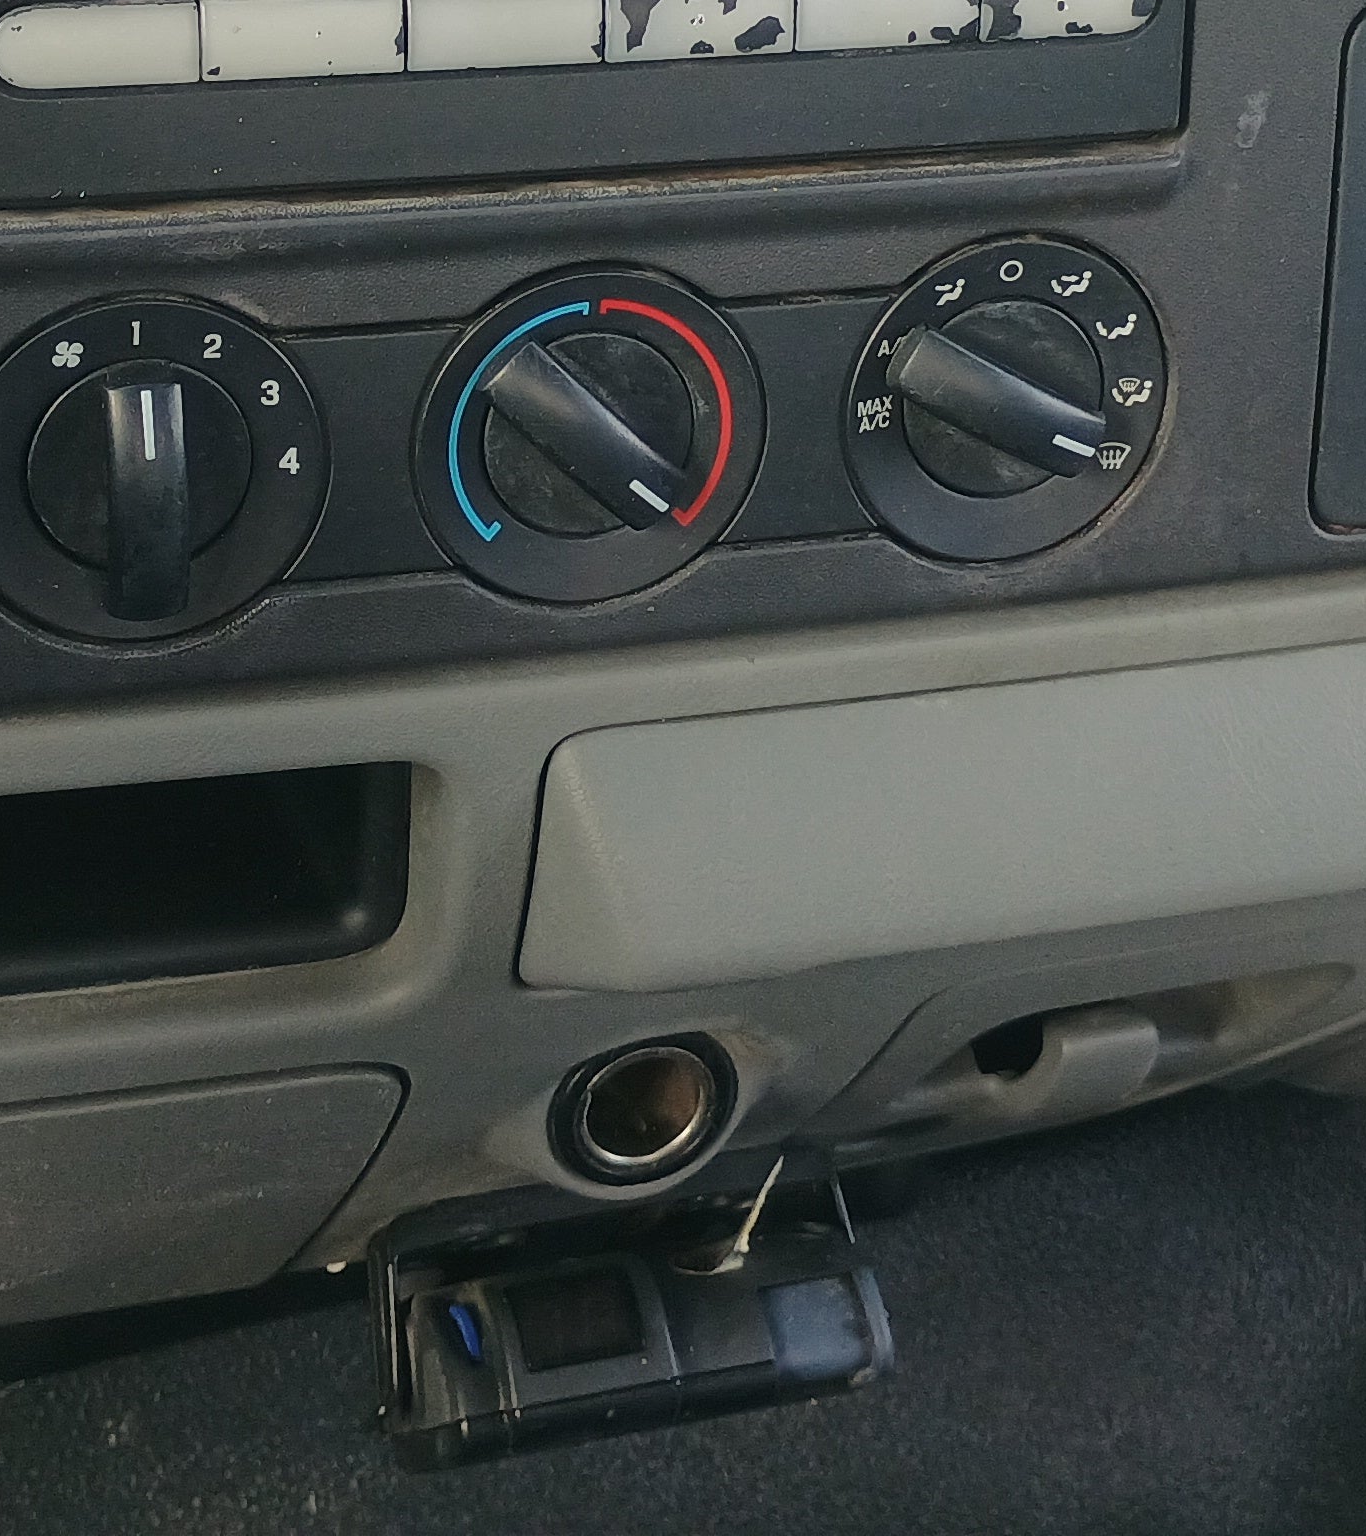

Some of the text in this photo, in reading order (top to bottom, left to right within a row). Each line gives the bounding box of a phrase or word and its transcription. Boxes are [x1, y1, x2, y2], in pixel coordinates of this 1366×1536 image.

[131, 320, 141, 346] 1
[202, 333, 223, 359] 2
[260, 379, 281, 406] 3
[857, 394, 893, 418] MAX
[858, 411, 890, 434] A/C
[278, 446, 301, 475] 4
